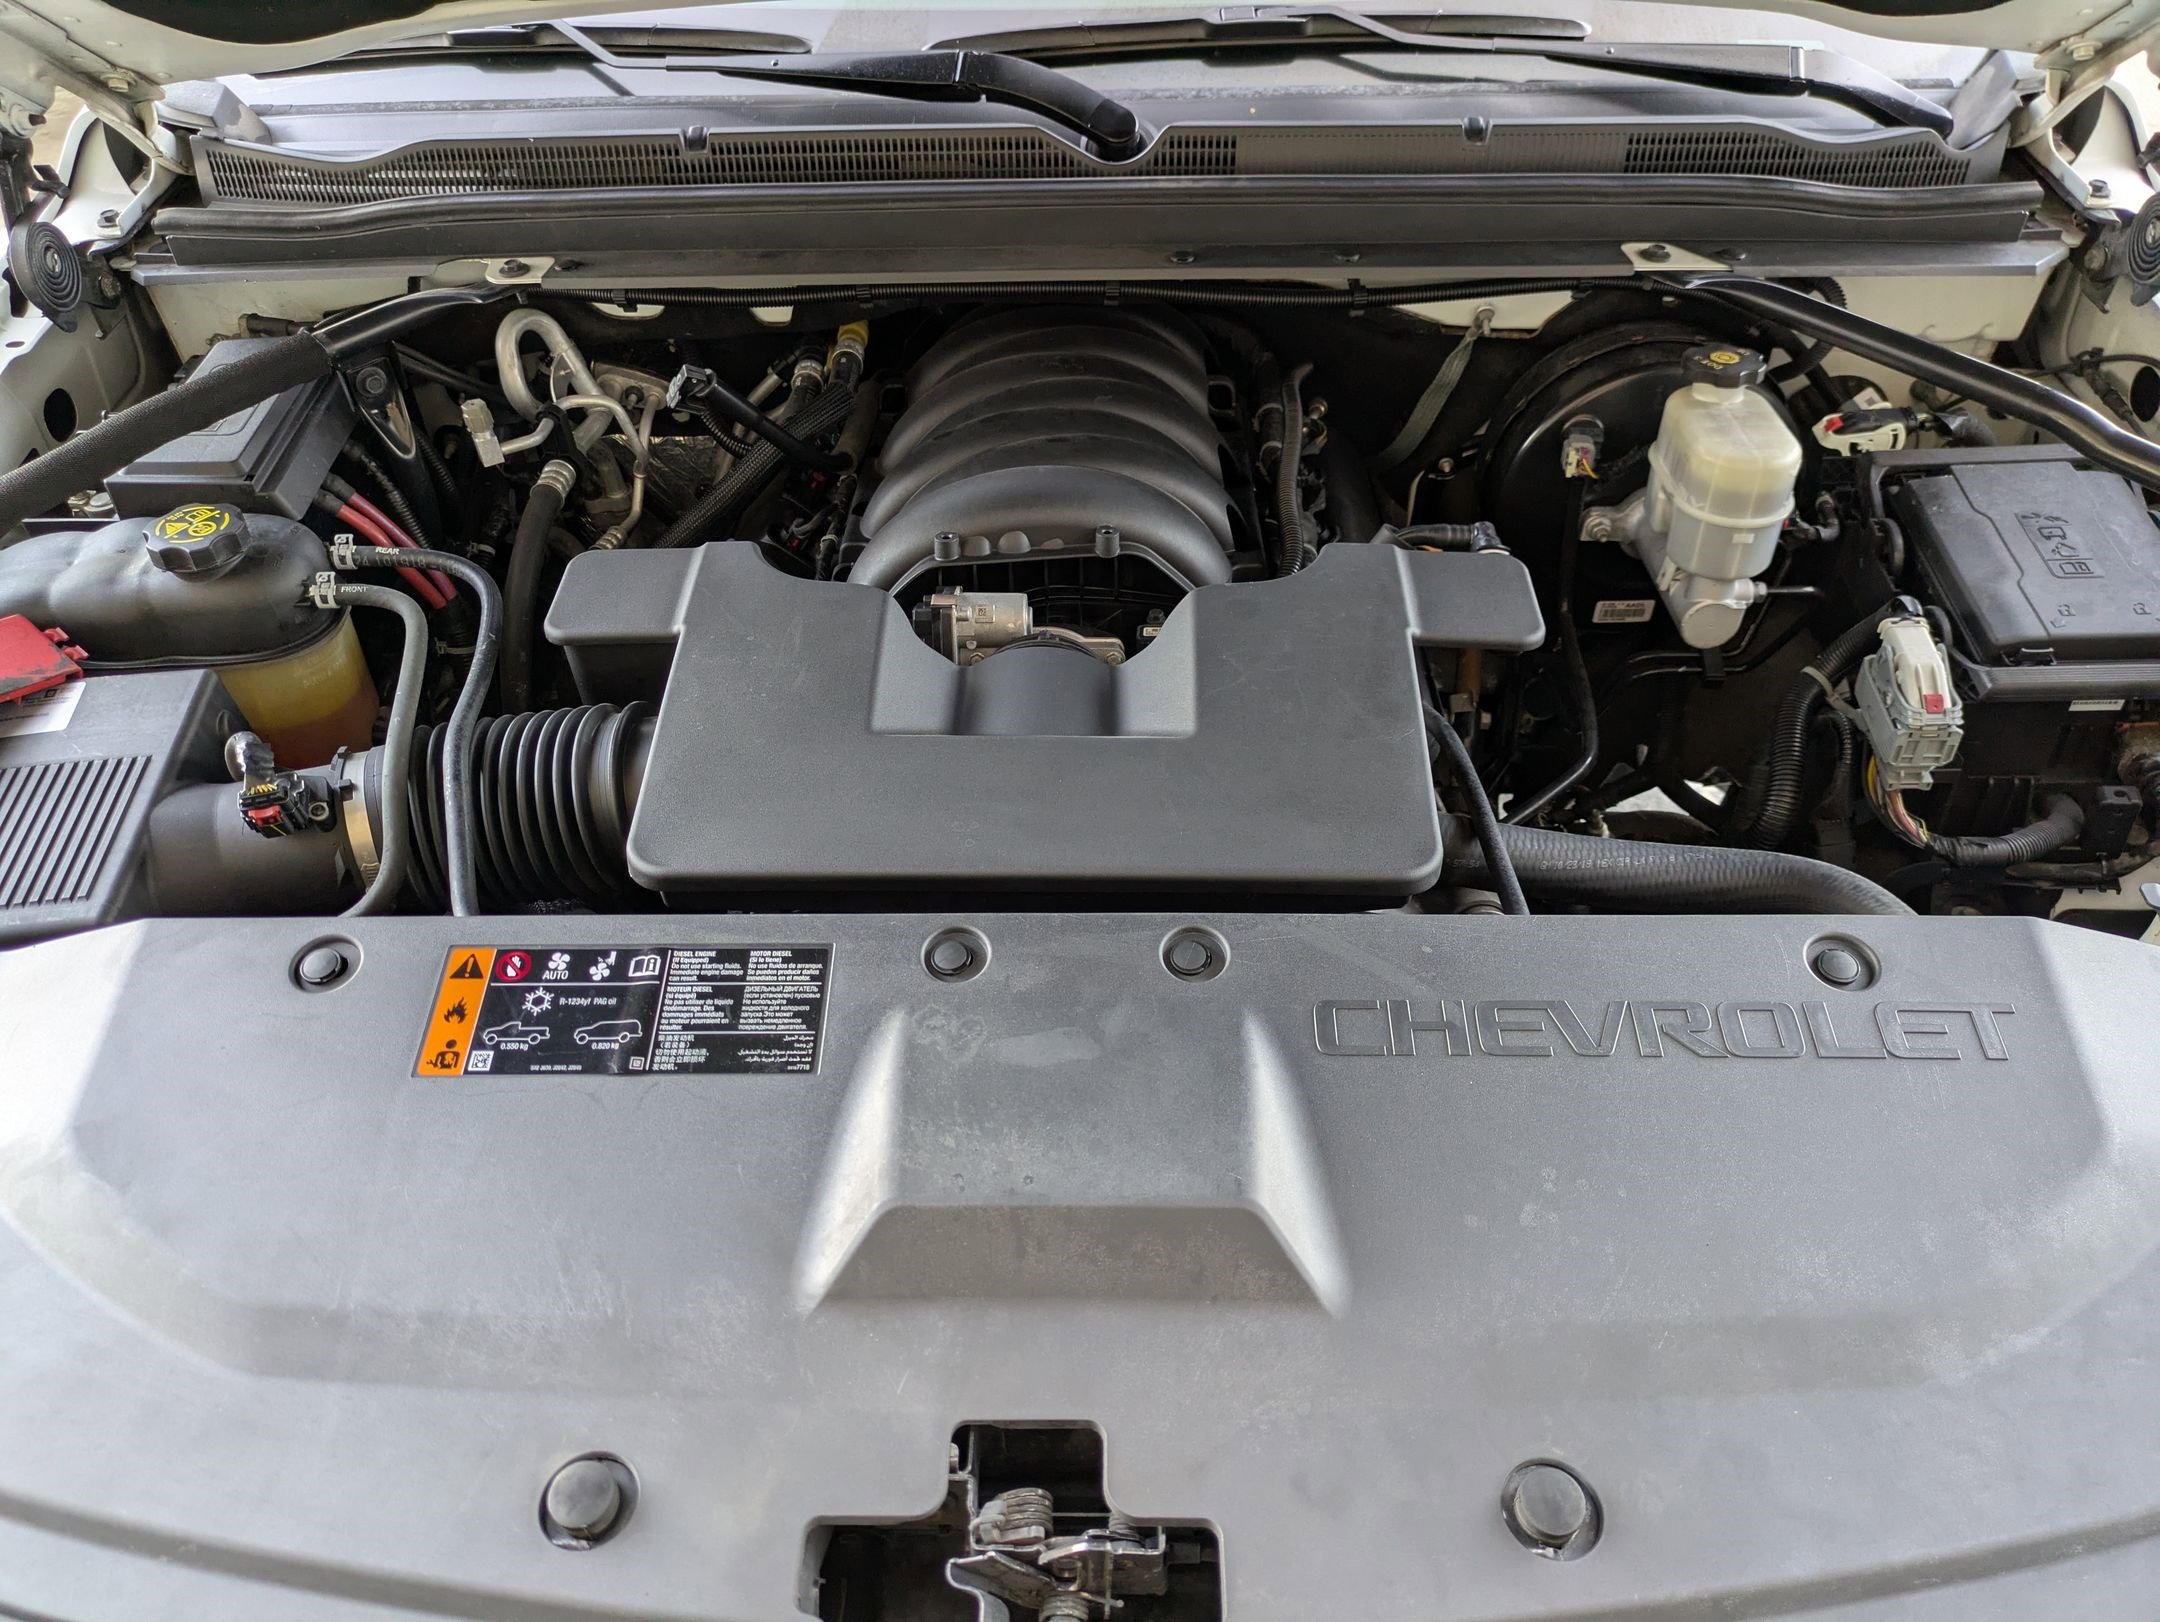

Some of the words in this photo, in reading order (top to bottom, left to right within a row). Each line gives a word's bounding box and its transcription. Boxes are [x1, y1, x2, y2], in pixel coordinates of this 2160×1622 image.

[375, 547, 400, 555] REAR
[542, 970, 569, 980] AUTO
[559, 998, 591, 1006] R-1234yf
[1312, 1000, 2016, 1061] CHEVROLET
